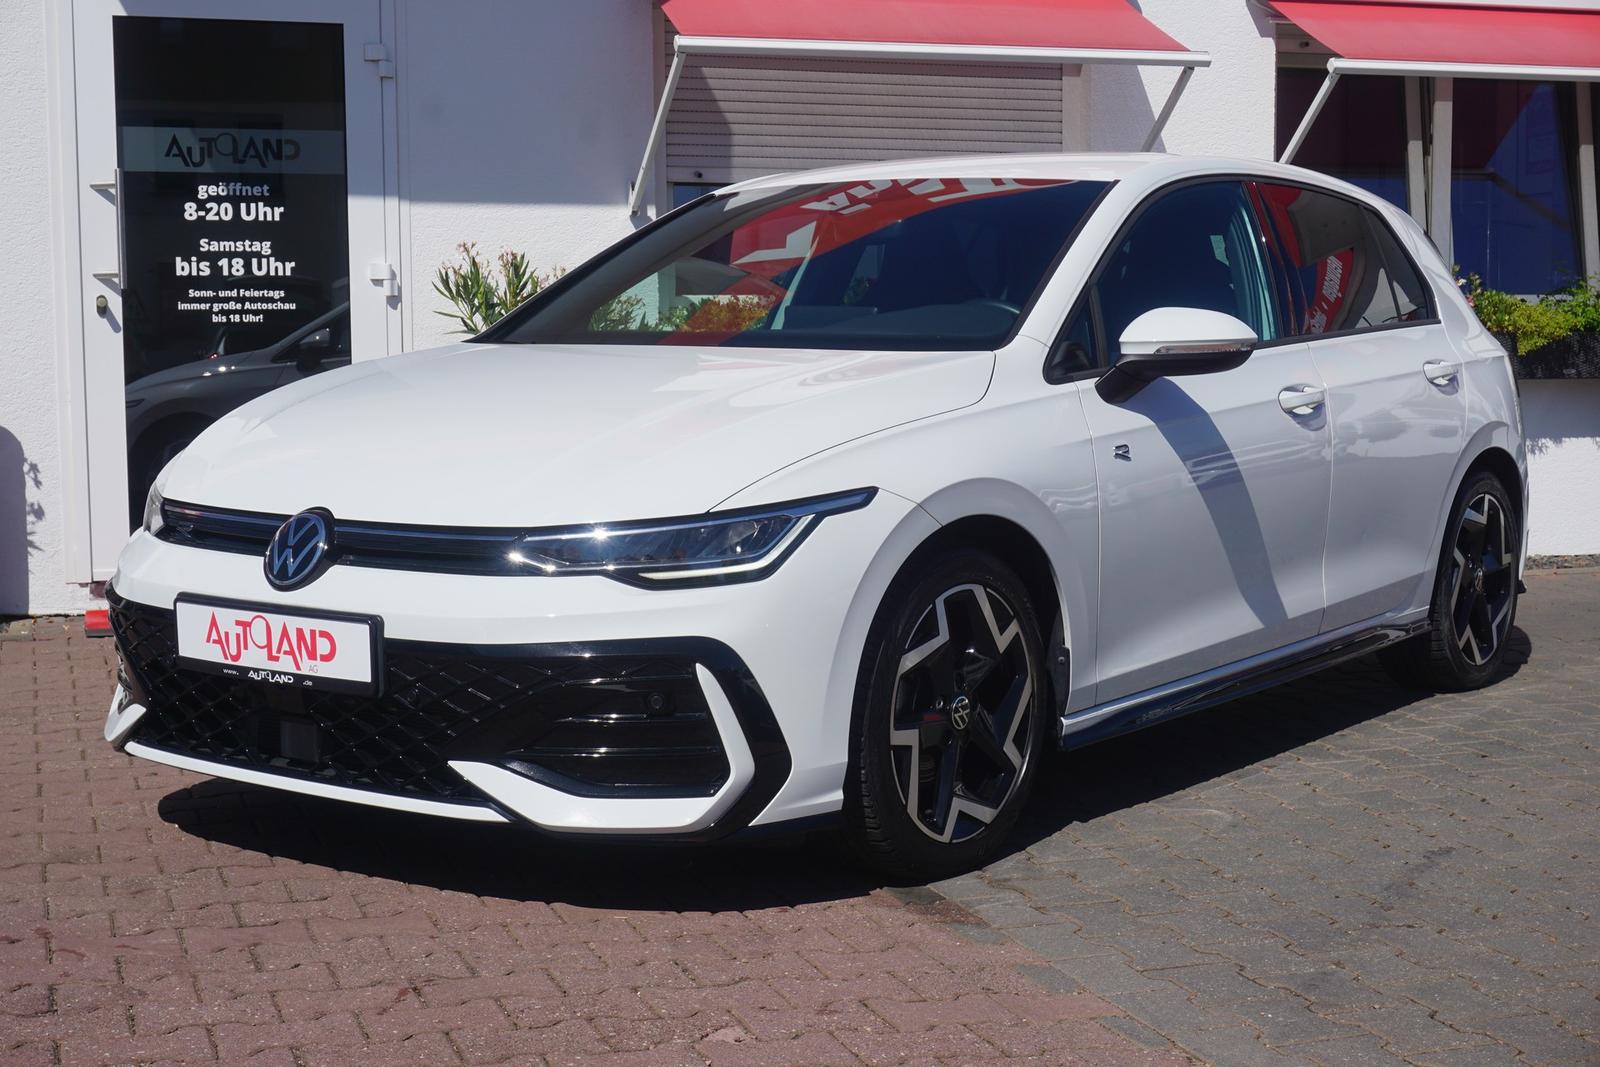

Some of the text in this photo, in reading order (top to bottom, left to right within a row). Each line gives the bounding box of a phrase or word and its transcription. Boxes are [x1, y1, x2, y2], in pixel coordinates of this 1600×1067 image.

[164, 132, 301, 168] AUTOLAND
[197, 182, 270, 199] geöffnet
[183, 202, 284, 221] 8-20 Uhr
[199, 238, 271, 255] Samstag
[175, 257, 295, 276] bis 18 Uhr
[188, 289, 285, 299] Sonn- und Feiertags
[212, 301, 242, 312] große
[244, 301, 296, 310] Autoschau
[212, 314, 264, 323] bis 18 Uhr!
[206, 611, 337, 671] AUTOLAND
[247, 669, 294, 684] AUTOLAND
[308, 664, 319, 674] AG
